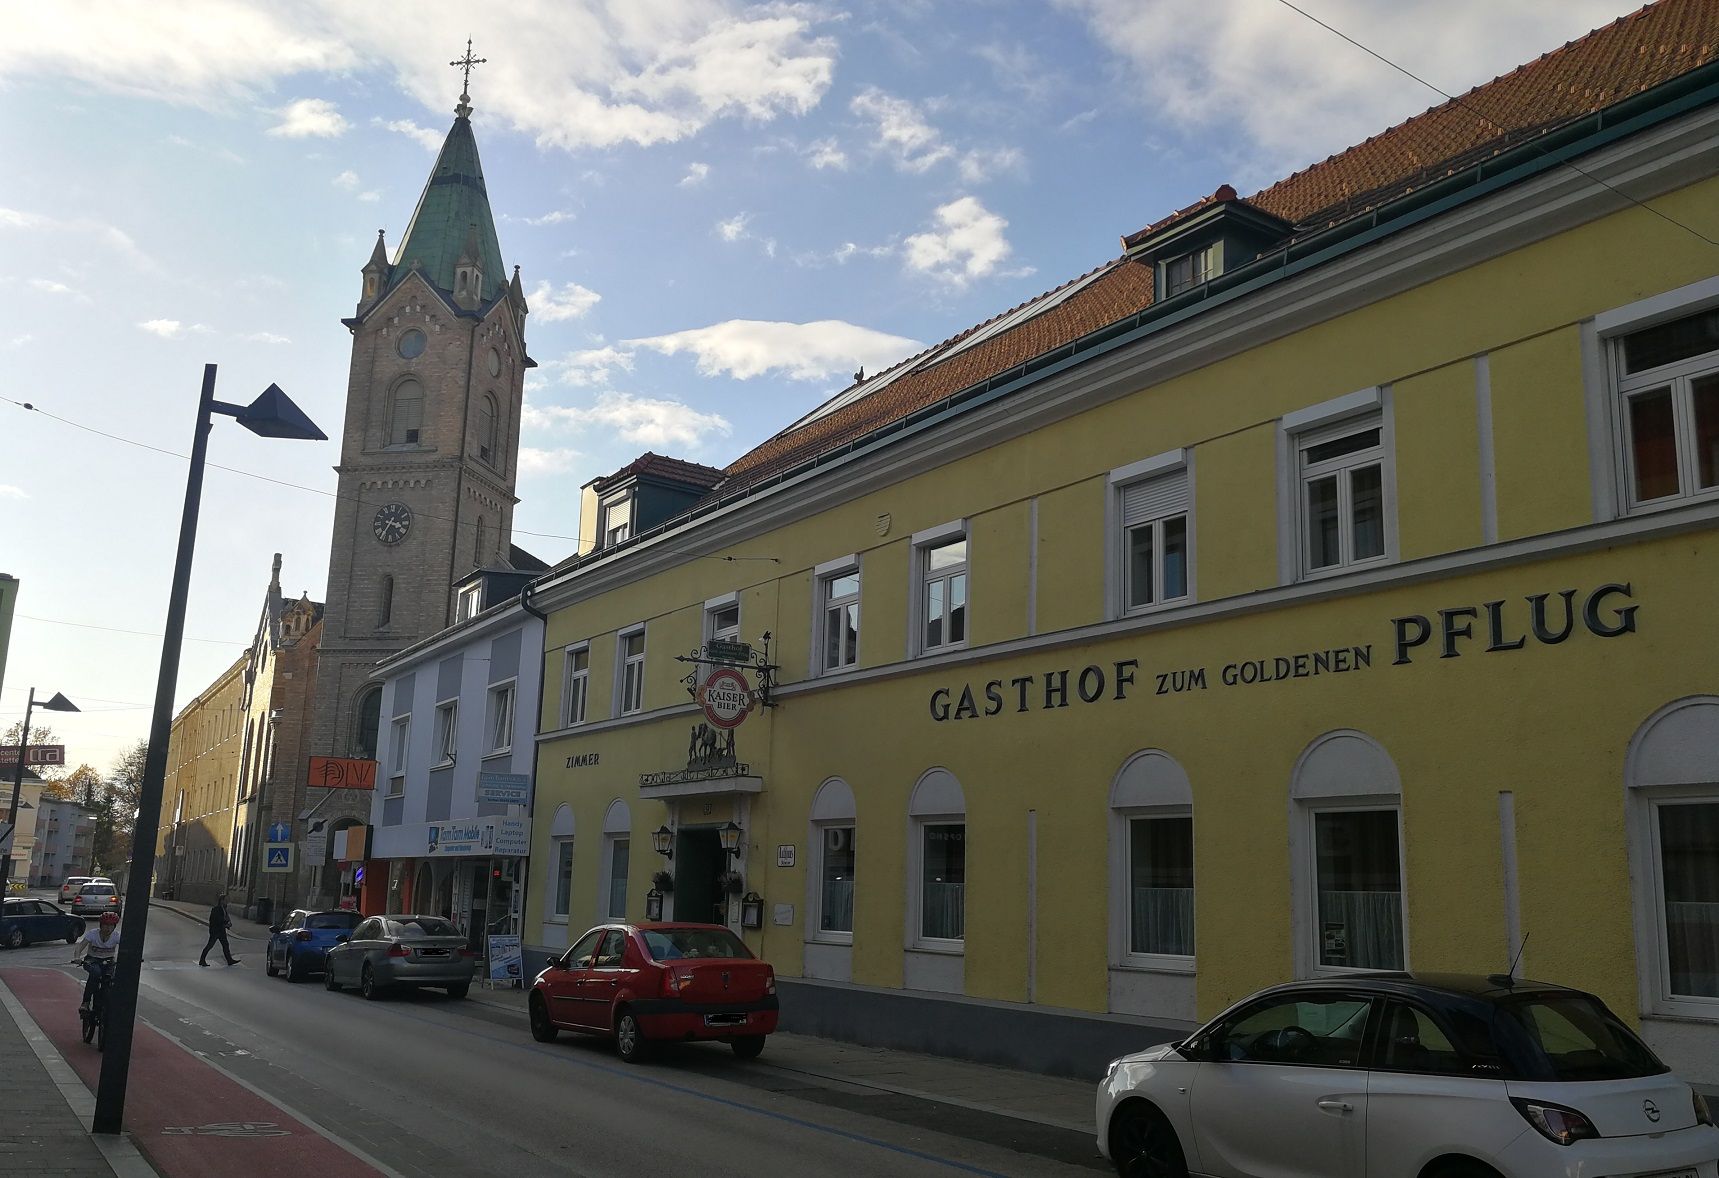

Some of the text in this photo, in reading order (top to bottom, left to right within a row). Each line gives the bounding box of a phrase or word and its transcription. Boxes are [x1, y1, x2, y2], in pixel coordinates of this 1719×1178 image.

[930, 581, 1640, 722] GASTHOF ZUM GOLDENEN PFLUG
[708, 690, 746, 706] KAISER
[717, 702, 737, 711] BIER
[566, 753, 599, 768] ZIMMER
[484, 790, 521, 798] SERVICE
[502, 820, 522, 828] Handy
[495, 838, 527, 846] Computer
